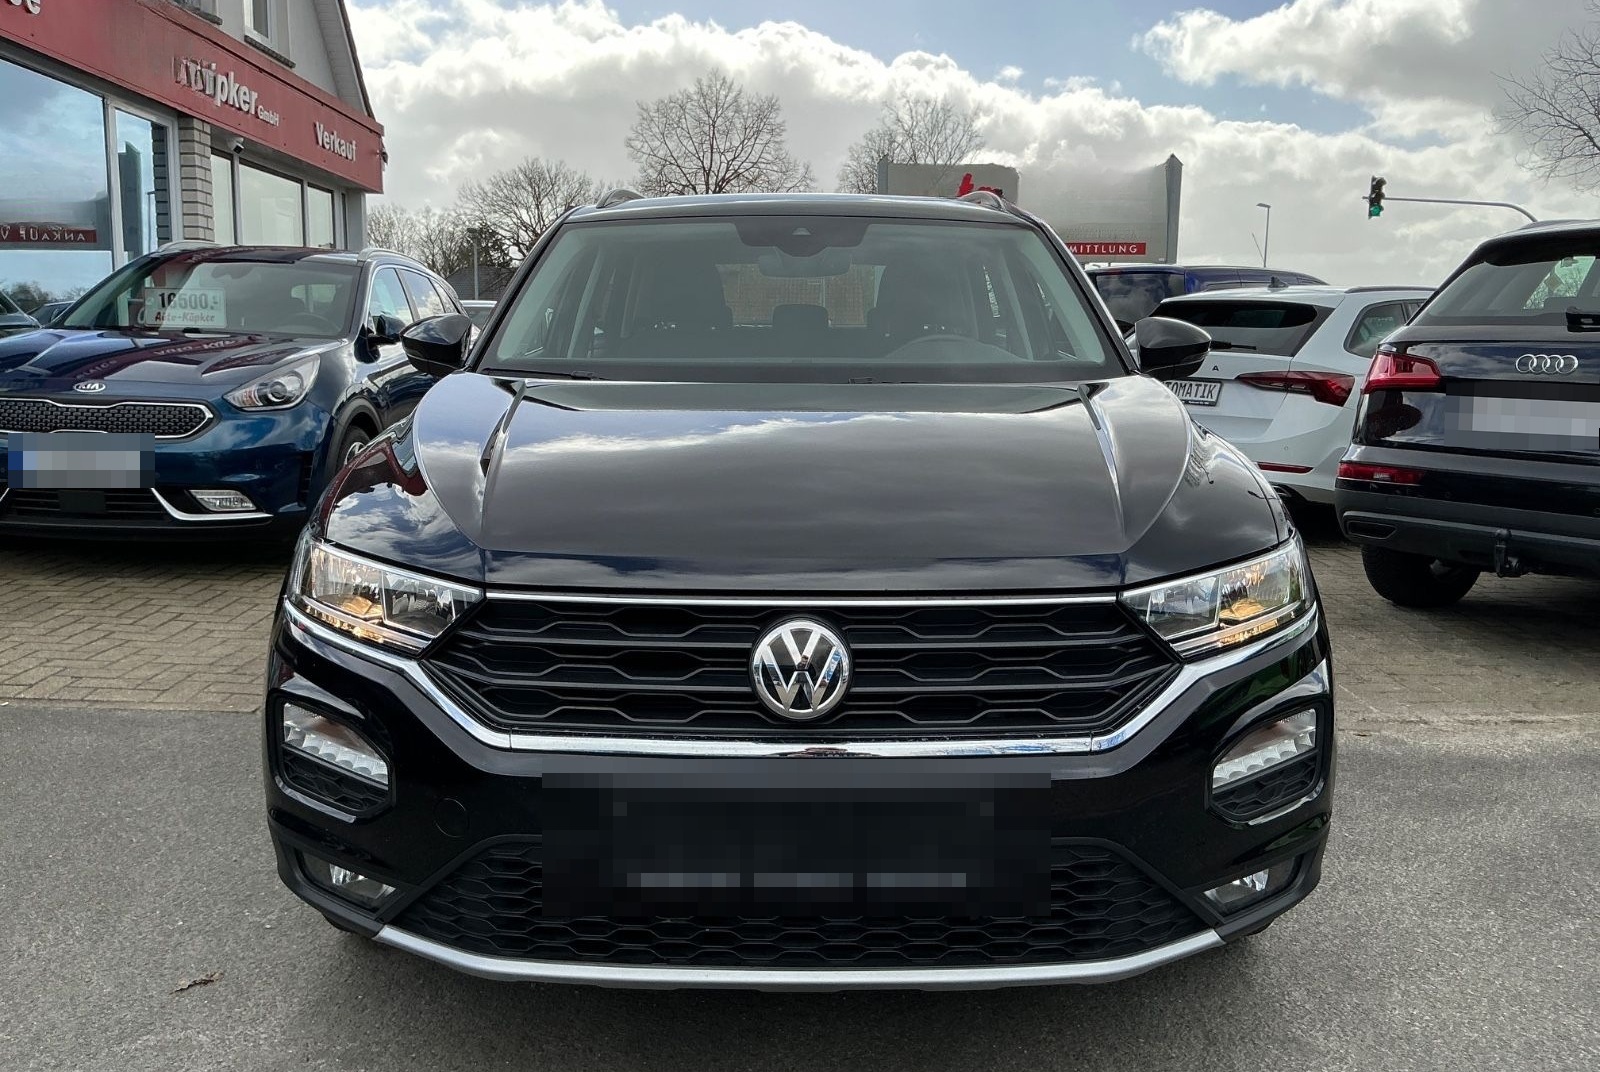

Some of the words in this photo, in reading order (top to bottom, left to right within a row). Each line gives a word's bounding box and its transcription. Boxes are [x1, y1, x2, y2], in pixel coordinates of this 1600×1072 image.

[257, 105, 279, 127] GmbH
[315, 121, 356, 161] Verkauf
[1161, 380, 1217, 400] TOMATIK
[752, 620, 850, 720] VW
